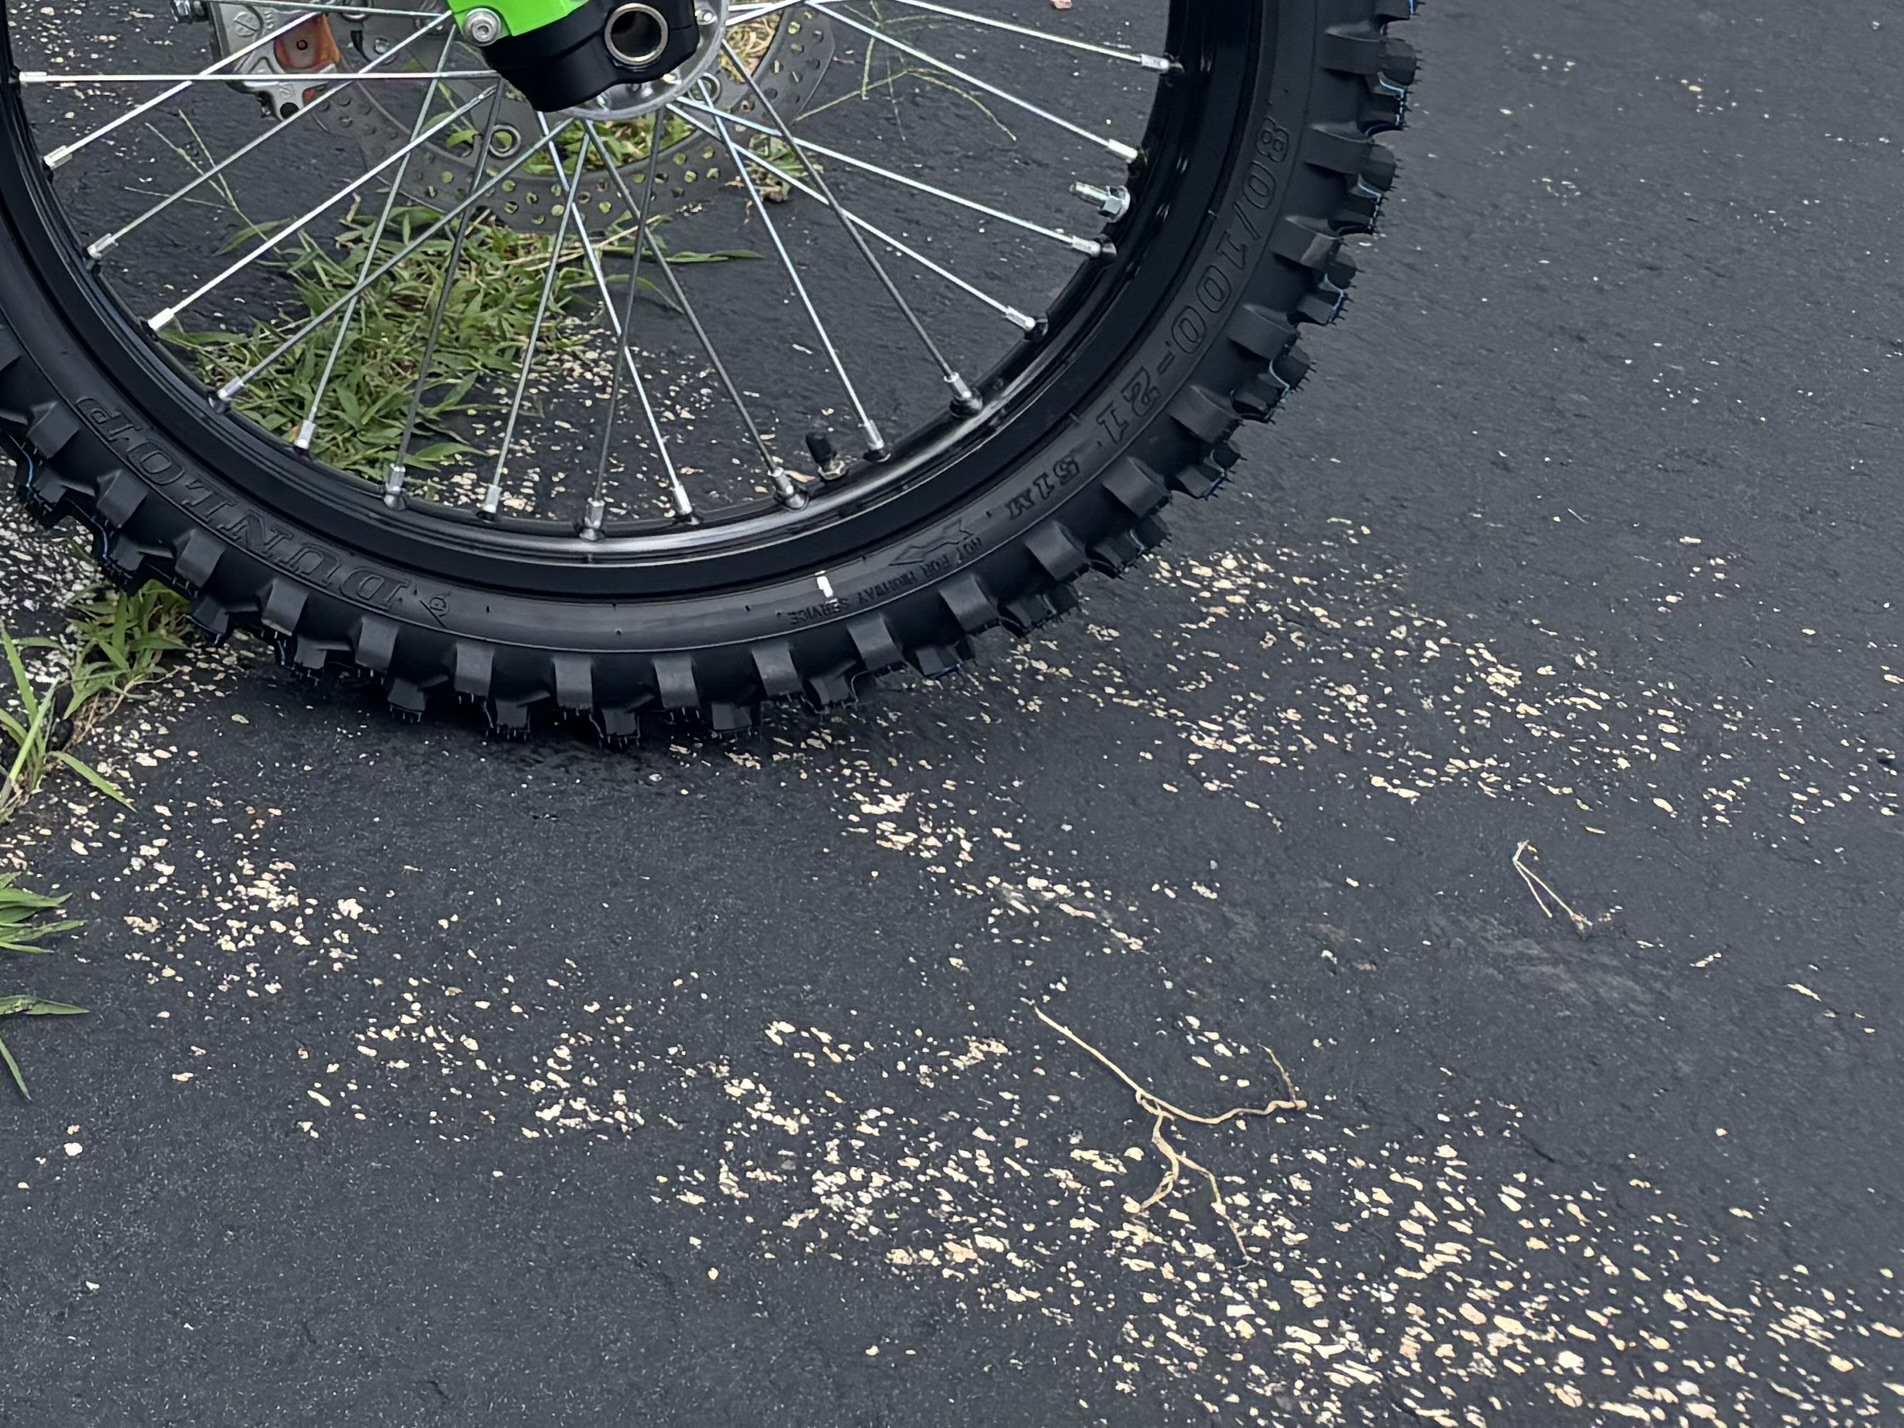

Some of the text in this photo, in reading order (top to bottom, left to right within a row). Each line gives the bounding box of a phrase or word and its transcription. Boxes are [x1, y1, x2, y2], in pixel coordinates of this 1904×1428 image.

[1009, 115, 1290, 520] 80/100-21 51M
[76, 396, 411, 610] DUNLOP
